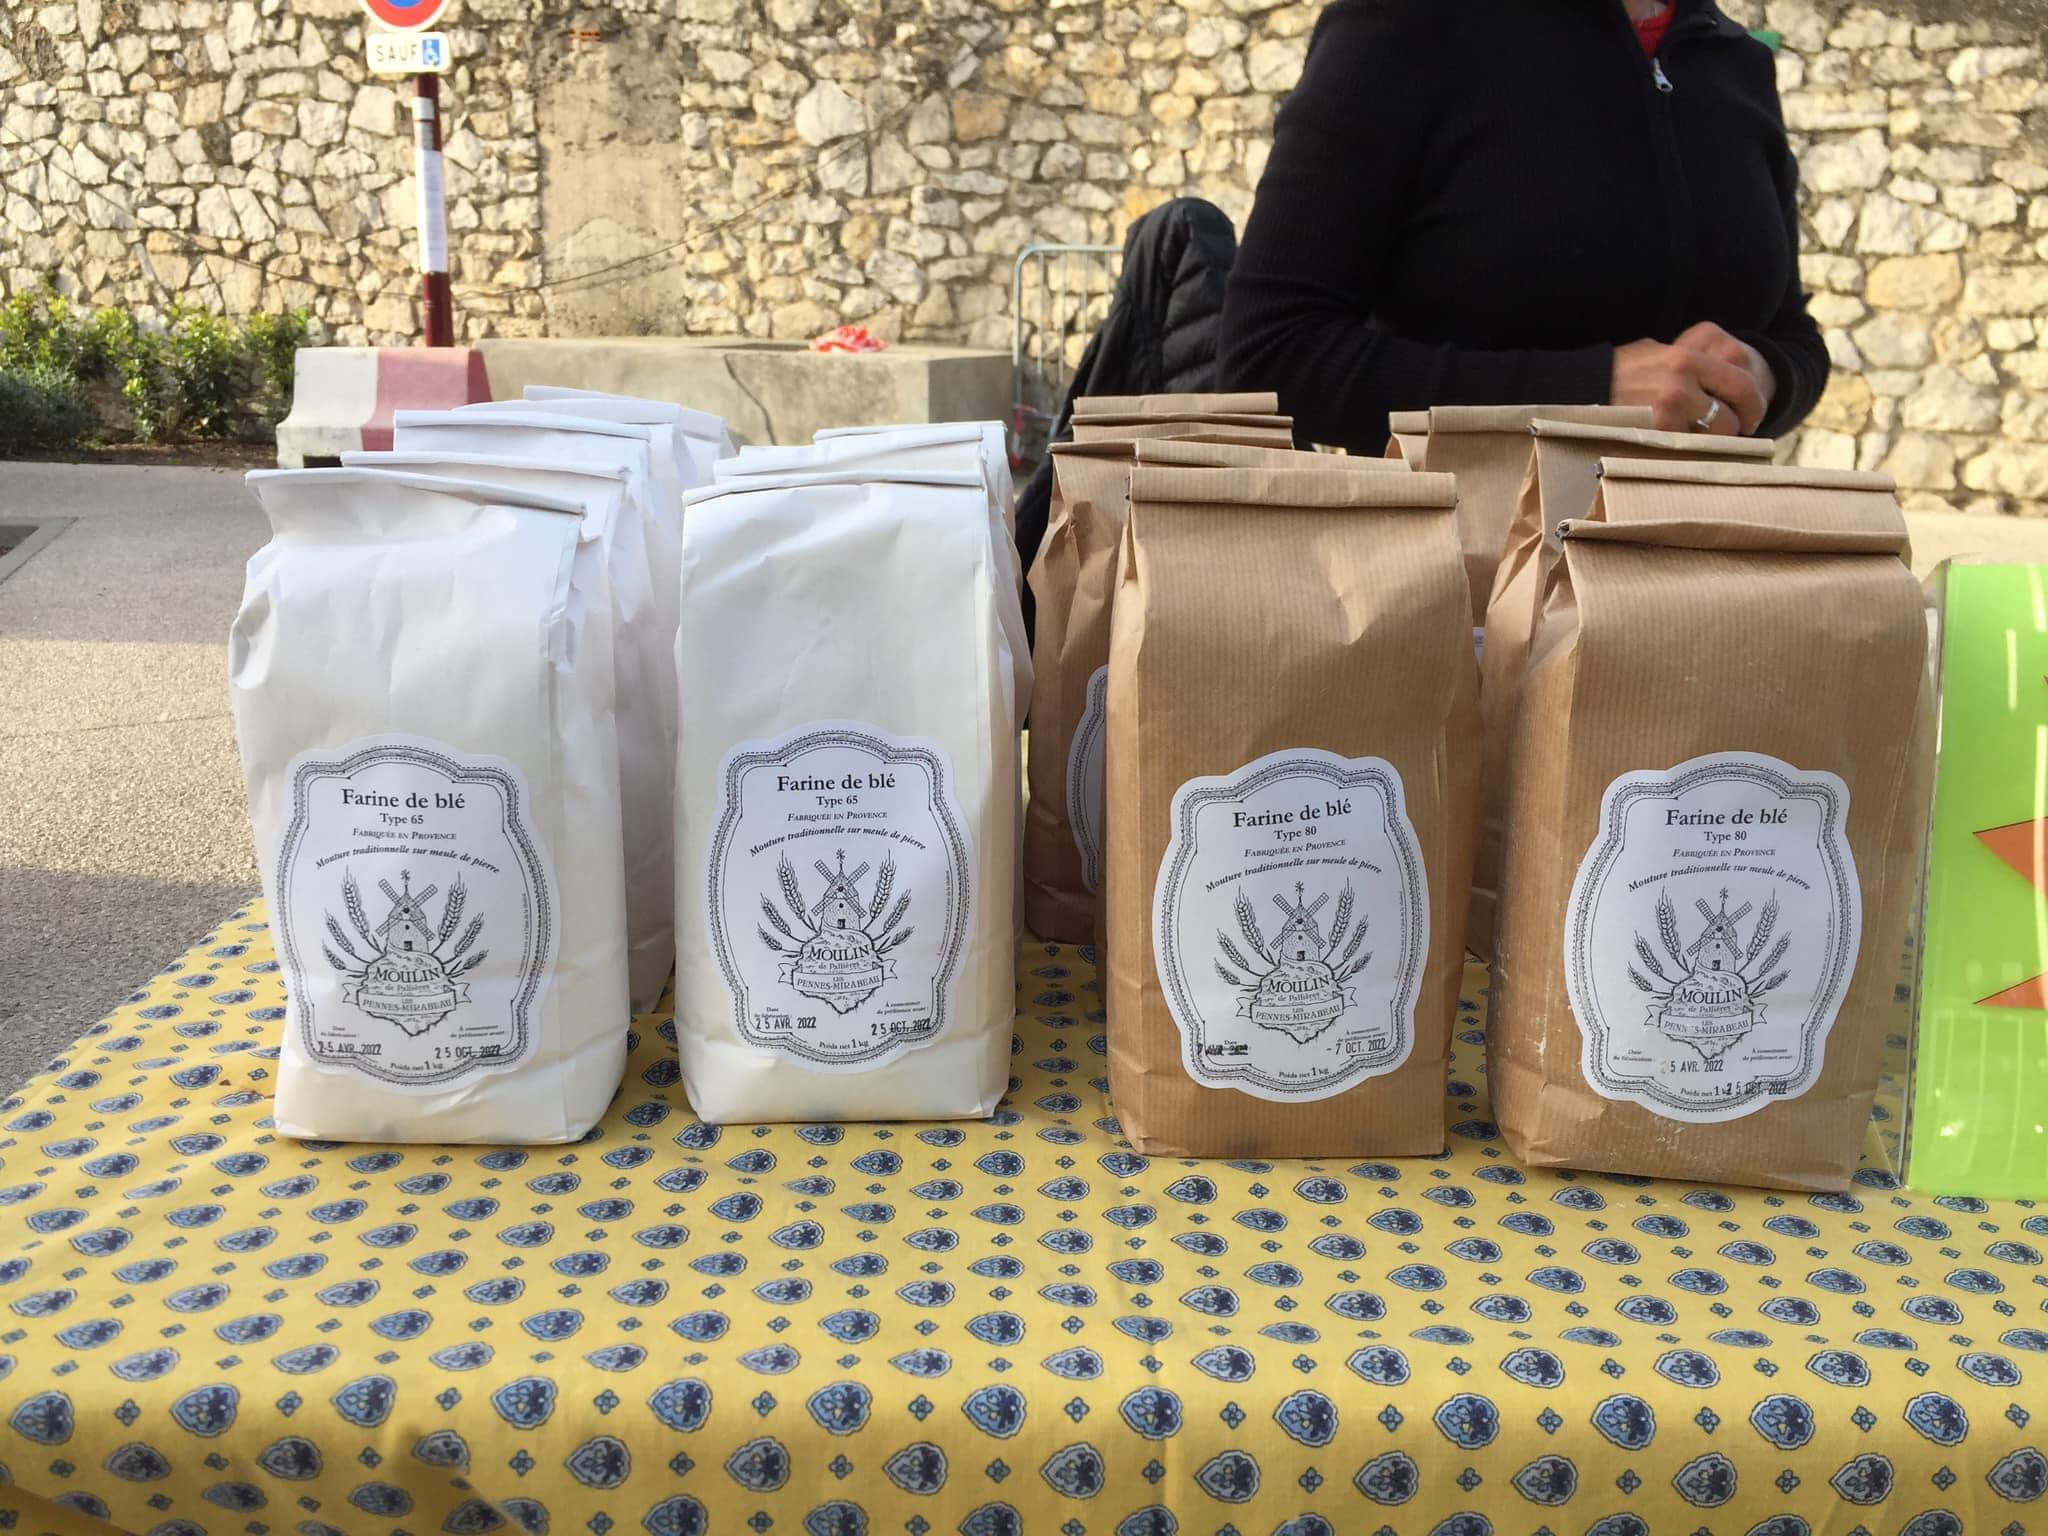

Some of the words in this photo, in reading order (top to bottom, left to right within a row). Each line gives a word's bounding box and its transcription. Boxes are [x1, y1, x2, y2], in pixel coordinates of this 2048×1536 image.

[376, 44, 417, 62] SAUF
[777, 775, 835, 791] Farine
[841, 774, 863, 790] de
[868, 773, 896, 788] blé
[342, 788, 400, 808] Farine
[405, 792, 429, 809] de
[436, 792, 466, 809] blé
[816, 796, 843, 808] Type
[846, 795, 858, 805] 65
[380, 813, 408, 826] Type
[411, 815, 424, 825] 65
[847, 811, 888, 820] PROVENCE
[1233, 810, 1294, 828] Farine
[1299, 804, 1321, 821] de
[1326, 798, 1352, 817] blé
[1665, 809, 1725, 826] Farine
[1731, 808, 1754, 824] de
[1759, 808, 1788, 824] blé
[411, 832, 457, 840] PROVENCE
[749, 835, 785, 857] Mouture
[787, 825, 845, 841] traditionnelle
[847, 826, 862, 834] sur
[863, 827, 889, 837] meule
[890, 831, 900, 839] de
[900, 834, 926, 850] pierre
[1274, 829, 1302, 842] Type
[1305, 825, 1317, 836] 80
[1704, 831, 1731, 844] Type
[1734, 831, 1747, 841] 80
[1292, 845, 1303, 853] EN
[1305, 839, 1346, 851] PROVENCE
[1734, 848, 1776, 857] PROVENCE
[316, 851, 350, 870] Mouture
[352, 845, 410, 856] traditionnelle
[430, 849, 458, 859] meule
[460, 853, 471, 862] de
[472, 857, 500, 874] pierre
[1205, 871, 1242, 892] Mouture
[1244, 858, 1303, 877] traditionnelle
[1306, 857, 1320, 865] sur
[1321, 855, 1347, 865] meule
[1348, 857, 1359, 866] de
[1358, 859, 1382, 875] pierre
[1627, 872, 1667, 892] Mouture
[1670, 863, 1730, 877] traditionnelle
[1749, 866, 1775, 875] meule
[1776, 869, 1786, 878] de
[1785, 873, 1811, 890] pierre
[808, 945, 871, 961] MOULIN
[374, 967, 441, 983] MOULIN
[797, 975, 881, 990] PENNES-MIRABEAU
[1267, 975, 1330, 994] MOULIN
[1679, 988, 1743, 1004] MOULIN
[362, 999, 452, 1012] PENNES-MIRABEAU
[1255, 1005, 1341, 1021] PENNES-MIRABEAU
[797, 1016, 817, 1029] 2022
[912, 1018, 931, 1031] 2022
[1664, 1019, 1749, 1034] PENNS-MIRABEAU
[361, 1044, 382, 1055] 2022
[852, 1038, 857, 1049] 1
[1345, 1040, 1365, 1053] OCT.
[1368, 1038, 1386, 1051] 2022
[425, 1060, 430, 1070] 1
[1312, 1067, 1317, 1076] 1
[1704, 1060, 1724, 1072] 2022
[1714, 1086, 1719, 1096] 1
